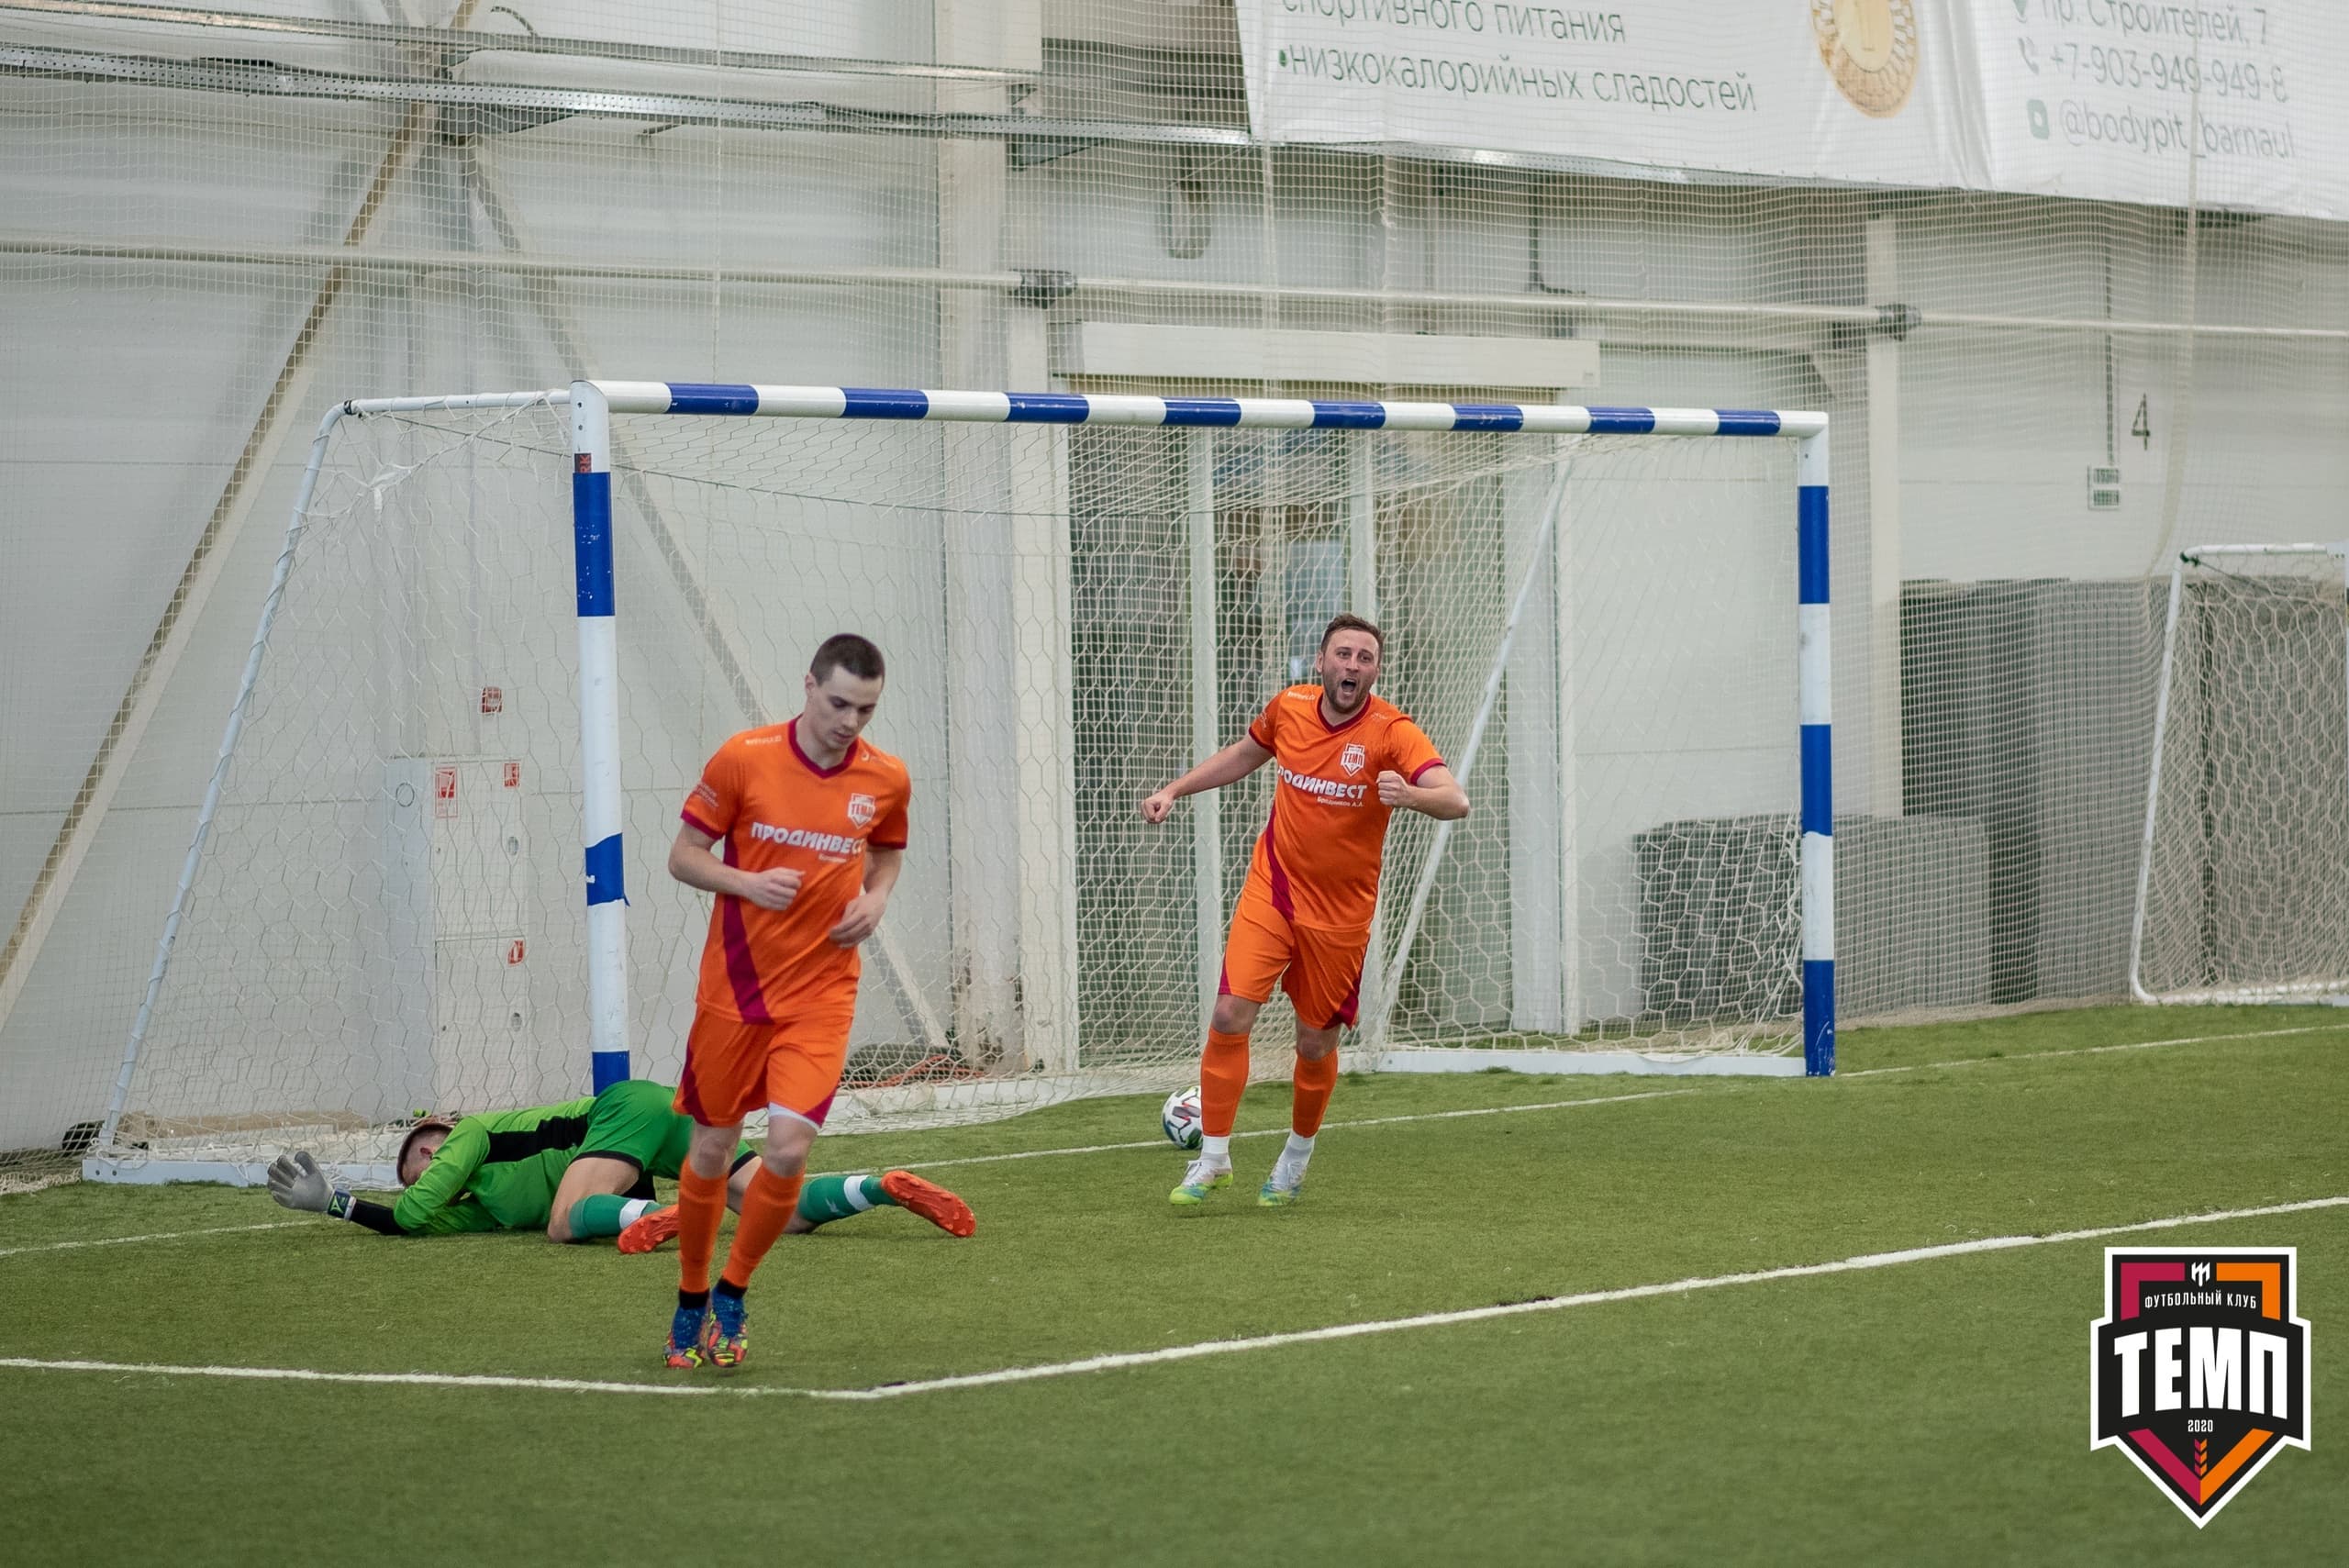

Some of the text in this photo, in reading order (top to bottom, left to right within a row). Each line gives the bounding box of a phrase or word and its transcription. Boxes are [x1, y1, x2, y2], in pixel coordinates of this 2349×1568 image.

[1495, 5, 1626, 43] питания
[1288, 43, 1757, 112] низкокалорийных сладостей
[2132, 393, 2151, 450] 4
[751, 822, 865, 854] ПРОДИНВЕС
